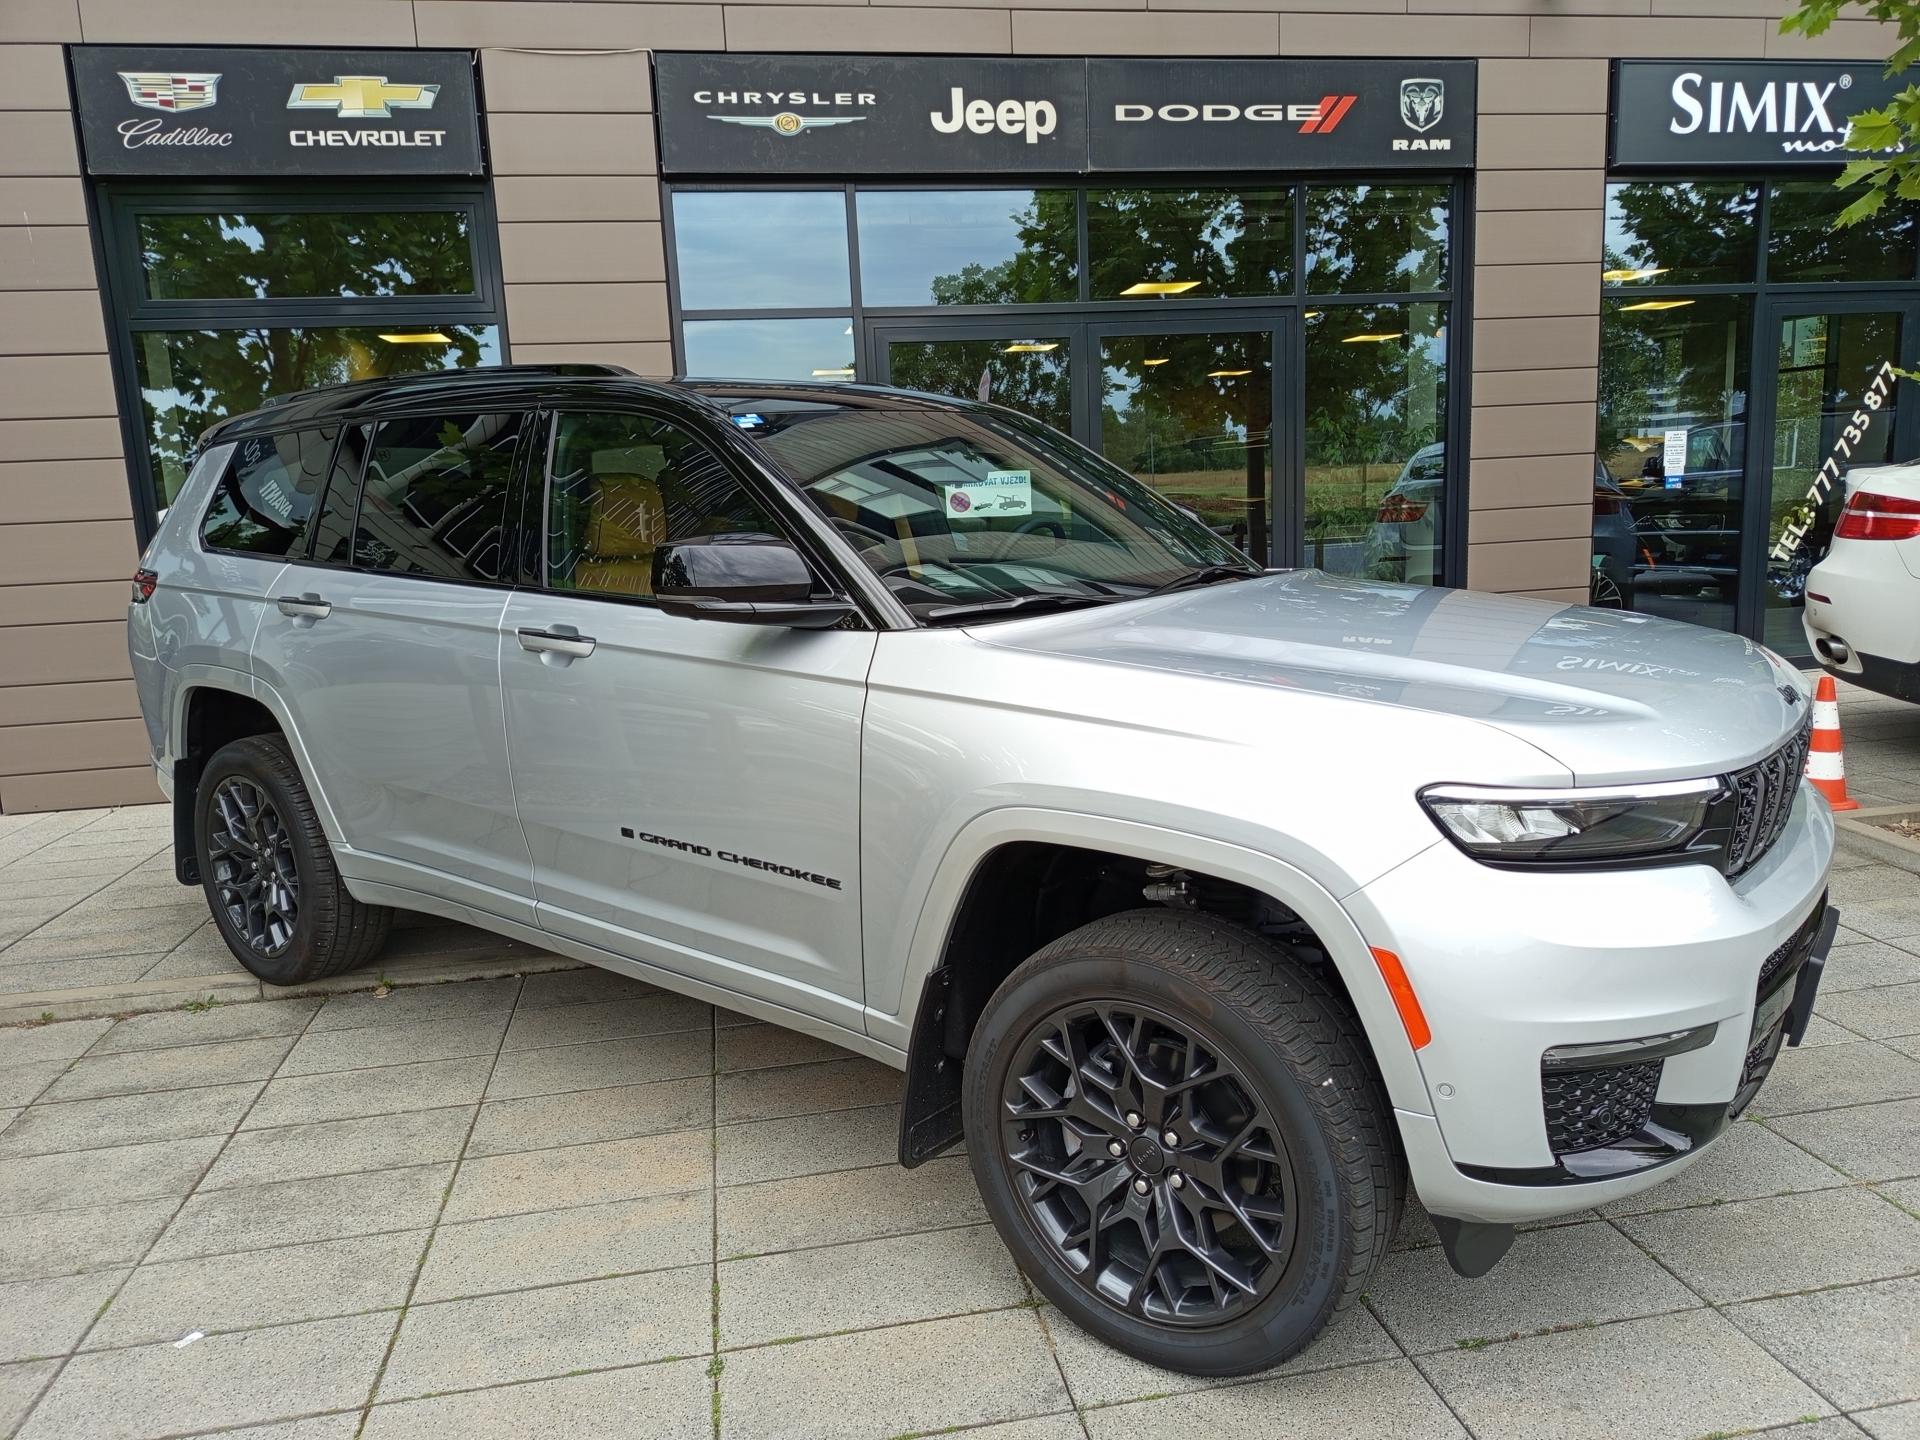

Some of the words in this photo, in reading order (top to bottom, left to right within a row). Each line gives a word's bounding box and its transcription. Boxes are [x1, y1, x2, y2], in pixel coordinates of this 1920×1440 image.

[693, 91, 876, 106] CHRYSLER
[930, 87, 1057, 144] Jeep
[1115, 104, 1323, 122] DODGE
[117, 118, 233, 150] Cadillac
[289, 130, 446, 147] CHEVROLET
[1392, 139, 1451, 151] RAM
[1806, 456, 1840, 507] 777
[1834, 409, 1870, 459] 735
[1864, 360, 1897, 412] 877
[639, 831, 711, 857] GRAND
[717, 850, 842, 890] CHEROKEE
